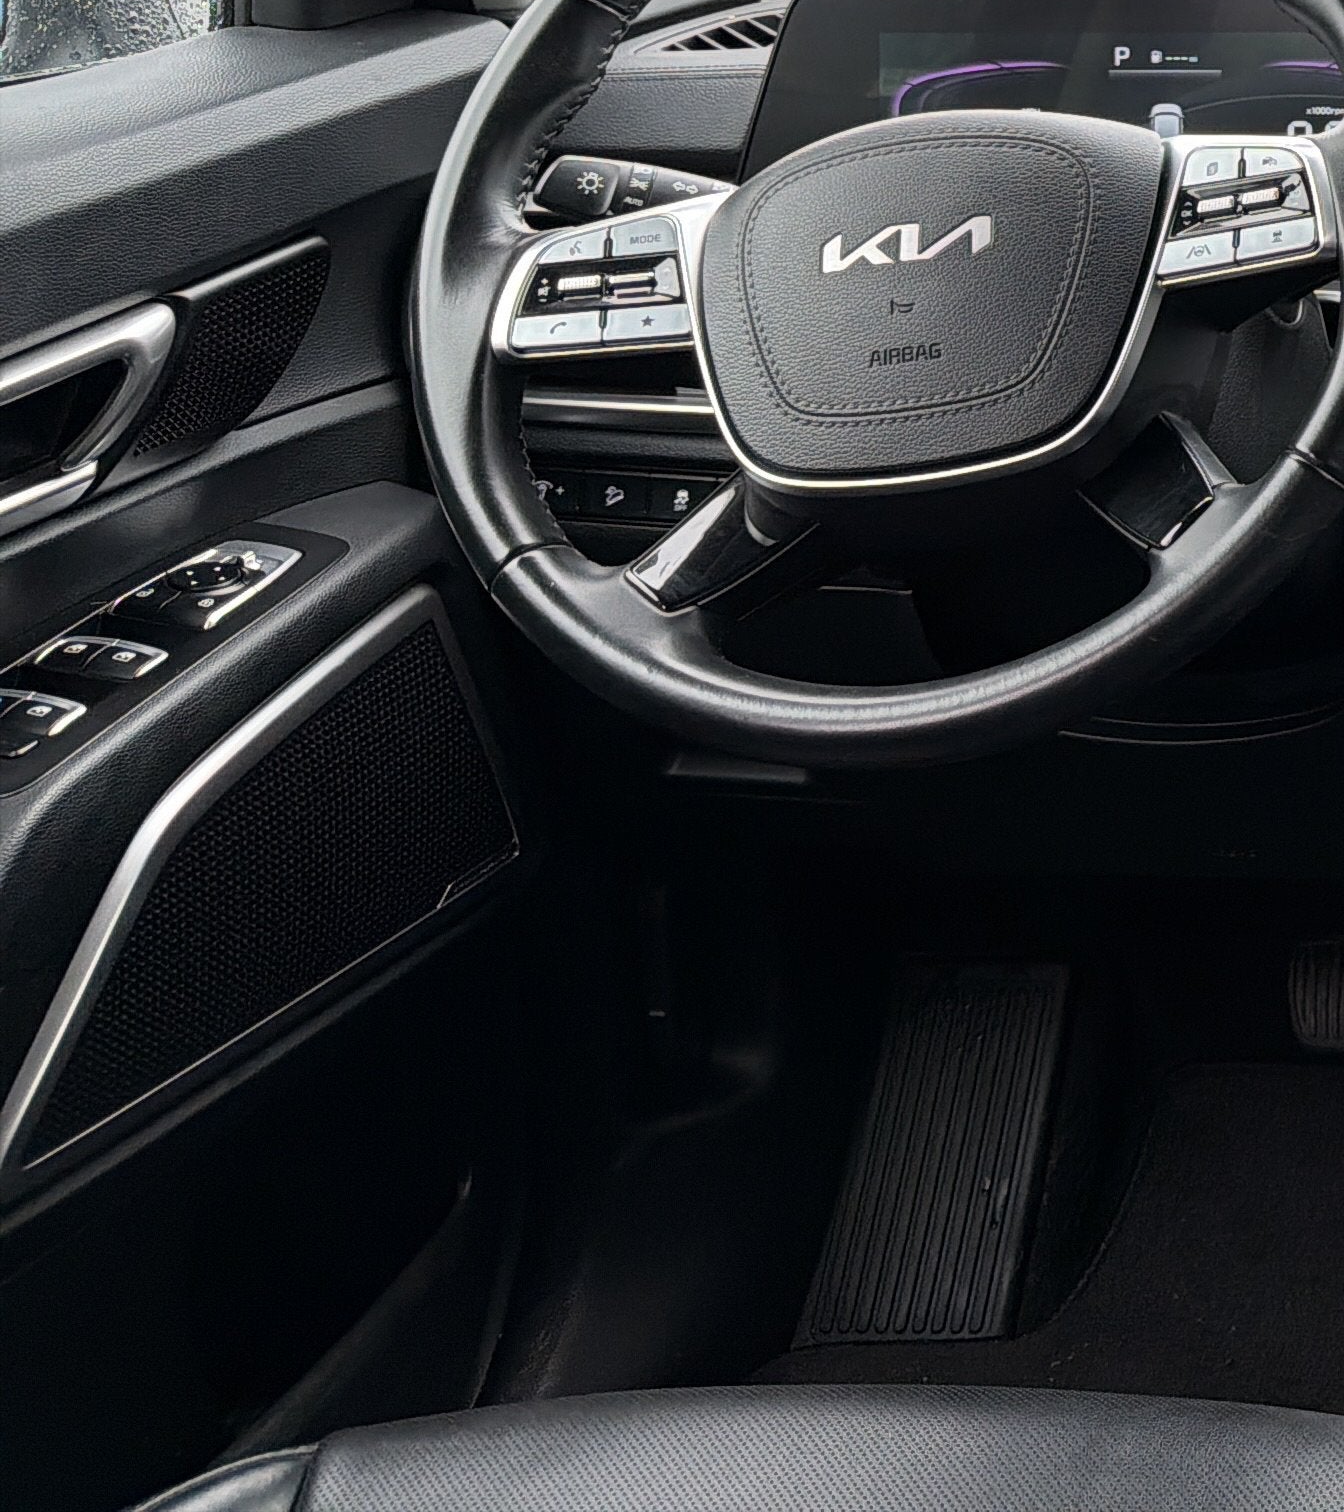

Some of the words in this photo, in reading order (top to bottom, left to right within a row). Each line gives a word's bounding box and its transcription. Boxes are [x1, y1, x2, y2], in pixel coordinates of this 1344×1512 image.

[1113, 45, 1131, 67] P
[623, 196, 644, 207] AUTO
[629, 233, 661, 245] MODE
[822, 215, 992, 274] KIA
[868, 342, 943, 369] AIRBAG
